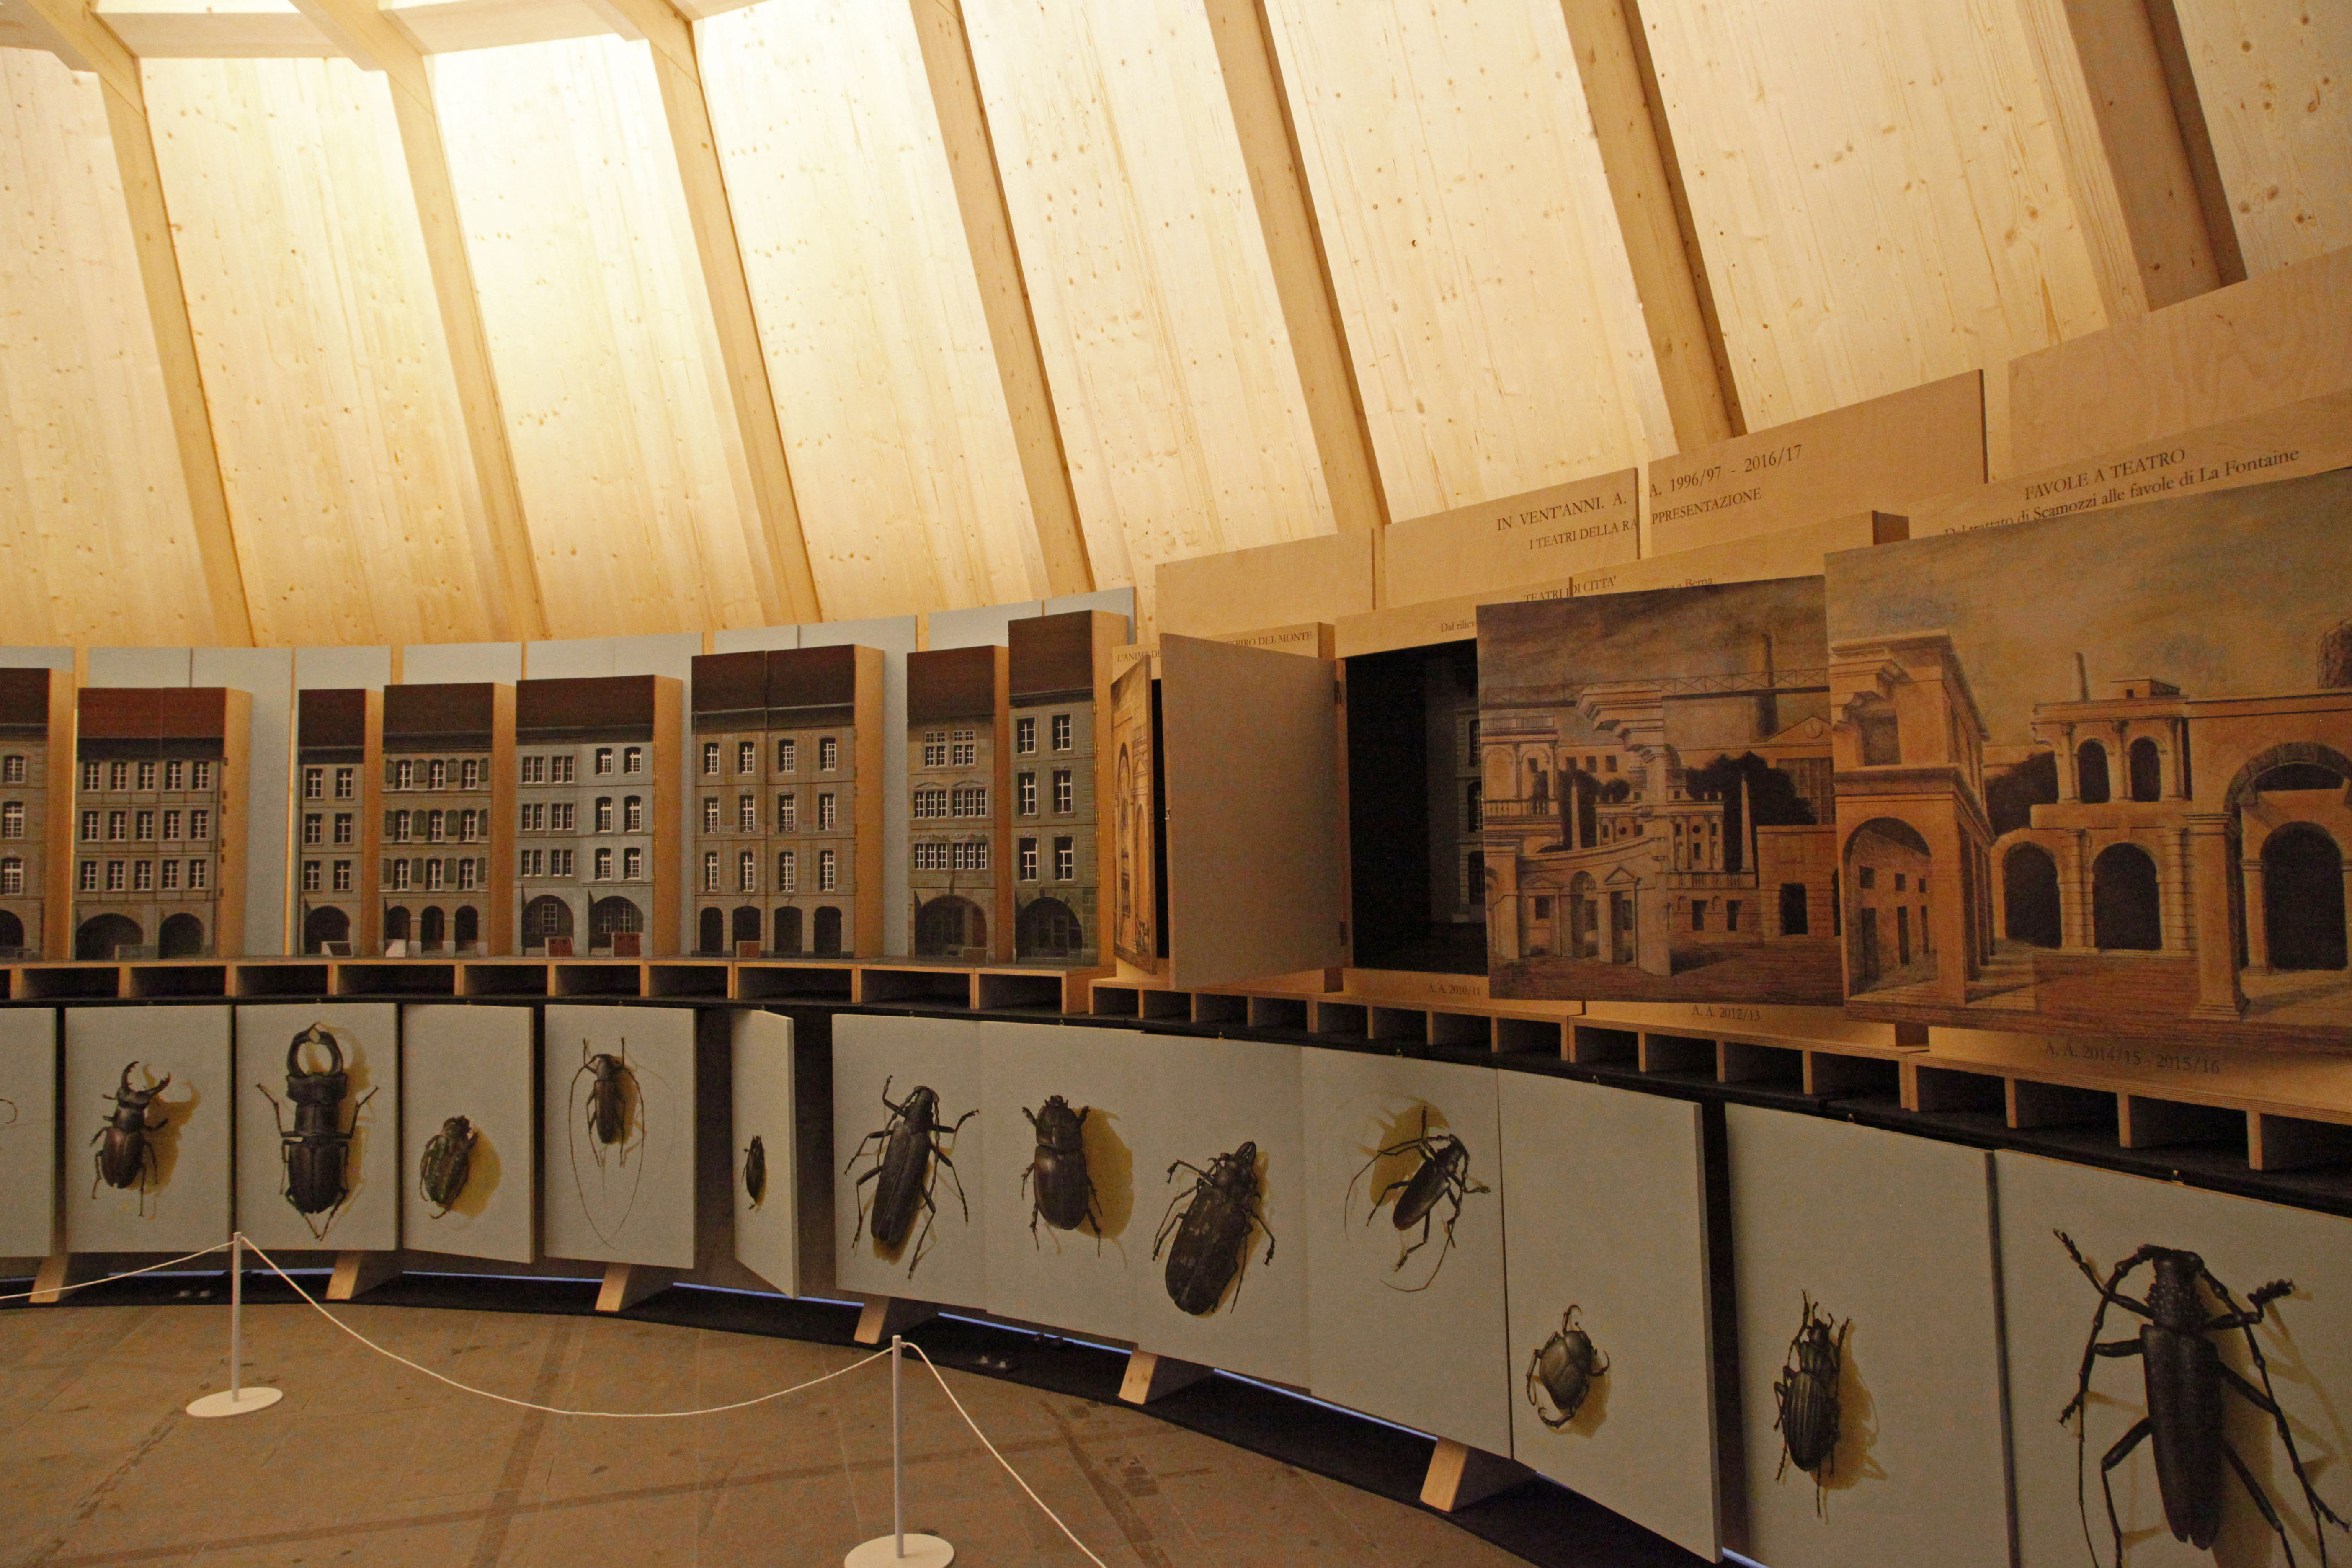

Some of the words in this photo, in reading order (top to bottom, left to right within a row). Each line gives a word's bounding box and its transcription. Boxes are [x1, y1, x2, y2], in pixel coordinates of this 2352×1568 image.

[1497, 516, 1512, 530] IN
[1519, 497, 1604, 525] VENT'ANNI.
[1612, 493, 1627, 506] A.
[1649, 483, 1661, 497] A.
[1671, 466, 1722, 491] 1996/97
[1745, 444, 1802, 472] 2016/17
[2025, 473, 2089, 500] FAVOLE
[2095, 469, 2106, 483] A
[2110, 449, 2186, 478] TEATRO
[2034, 493, 2097, 520] Scamozzi
[2102, 489, 2125, 505] alle
[2130, 477, 2174, 498] favole
[2179, 471, 2194, 487] di
[2200, 467, 2219, 482] La
[2225, 450, 2300, 476] Fontaine
[1536, 531, 1576, 548] TEATRI
[1579, 522, 1619, 540] DELLA
[1258, 636, 1277, 645] DEL
[1279, 631, 1312, 643] MONTE
[1441, 621, 1455, 632] Dal
[1457, 620, 1478, 630] riliev
[1449, 985, 1480, 996] 2010/11
[1692, 1005, 1702, 1016] A.
[1706, 1006, 1716, 1017] A.
[1719, 1007, 1760, 1021] 2012/13
[2083, 1045, 2141, 1065] 2014/15
[2157, 1053, 2220, 1074] 2015/16
